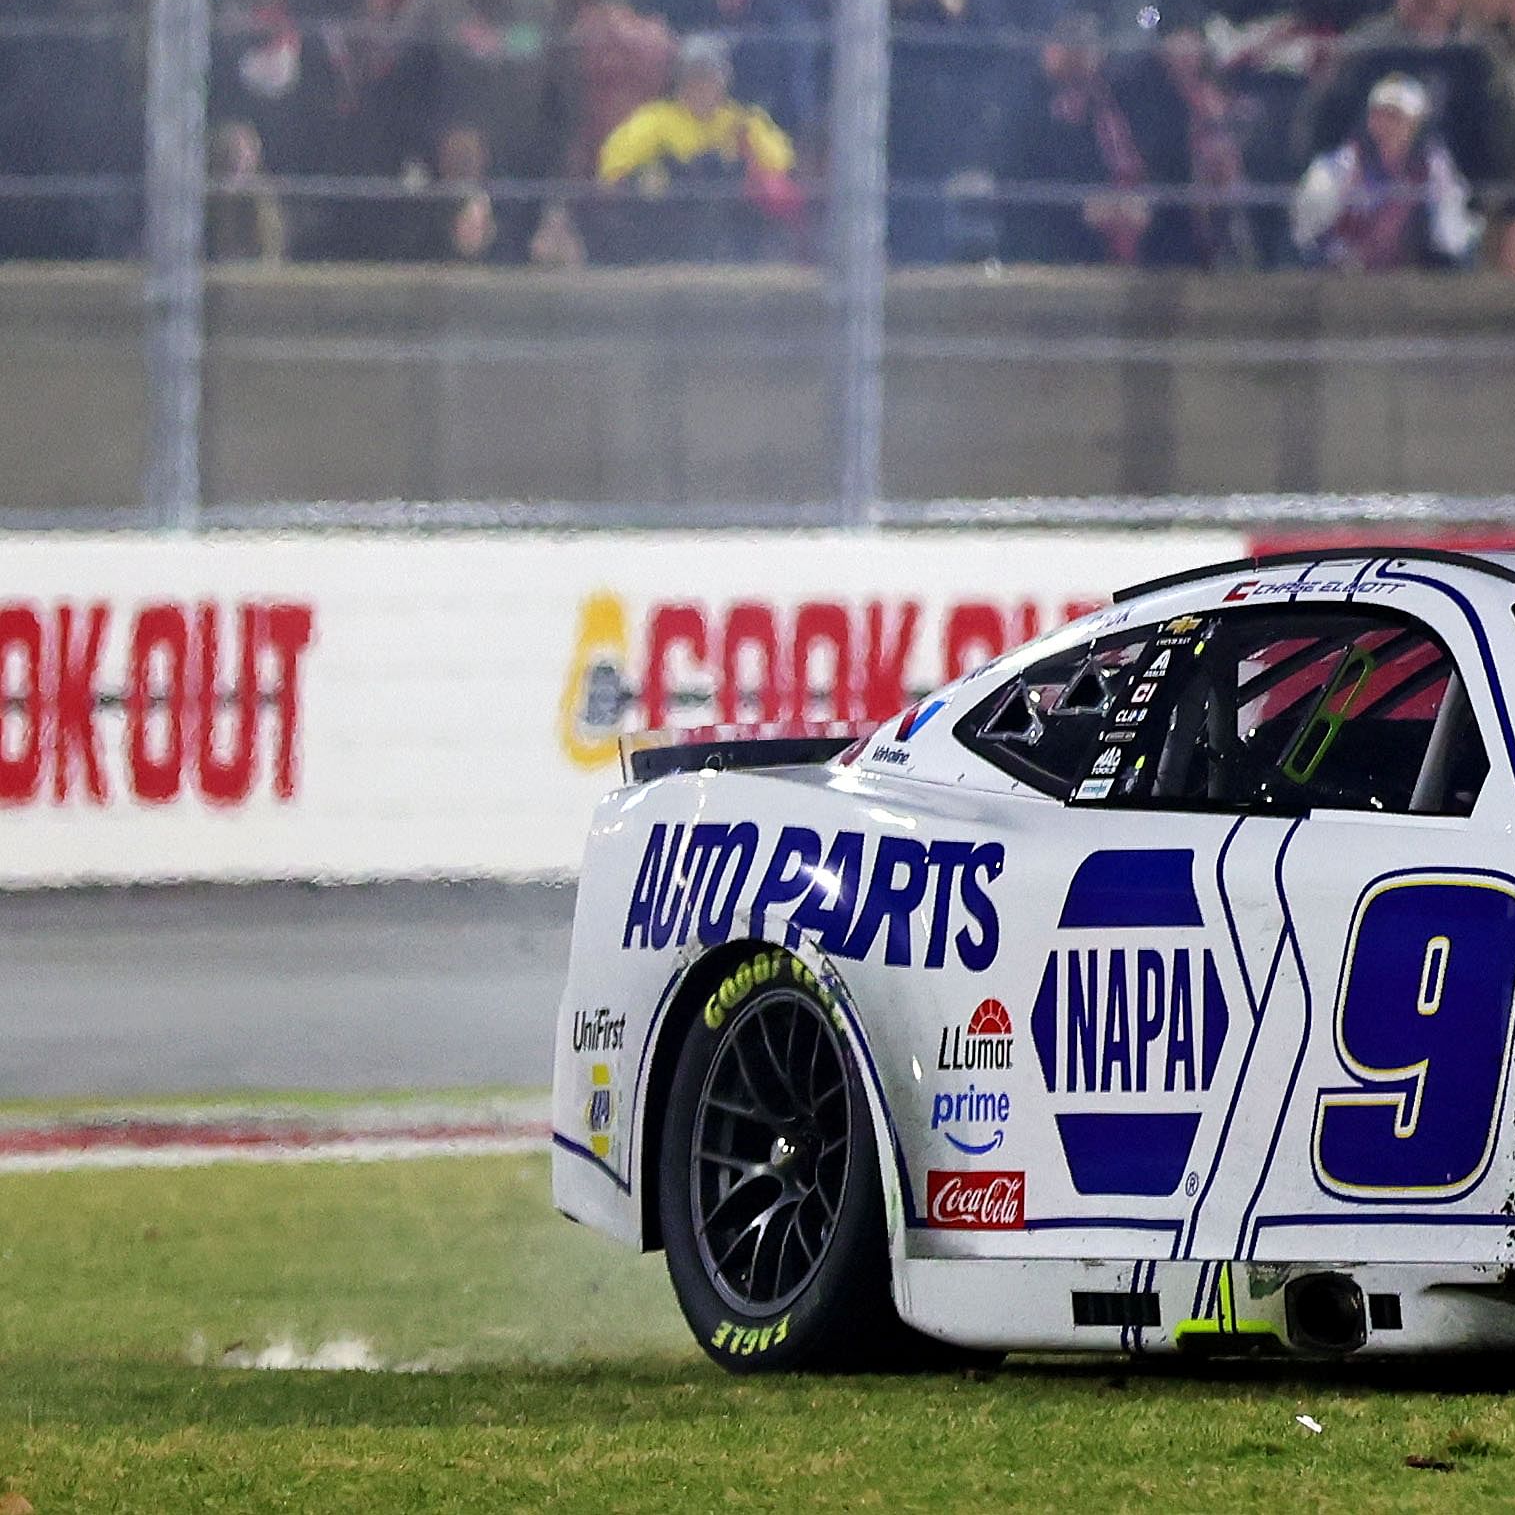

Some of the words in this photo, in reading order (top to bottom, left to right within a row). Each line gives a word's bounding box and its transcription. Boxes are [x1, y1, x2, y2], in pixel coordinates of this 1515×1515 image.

[622, 821, 760, 950] AUTO
[747, 827, 1006, 972] PARTS
[573, 1008, 626, 1053] UniFirst
[1065, 948, 1194, 1093] NAPA
[937, 1025, 1014, 1071] LLumar
[931, 1084, 1011, 1130] prime
